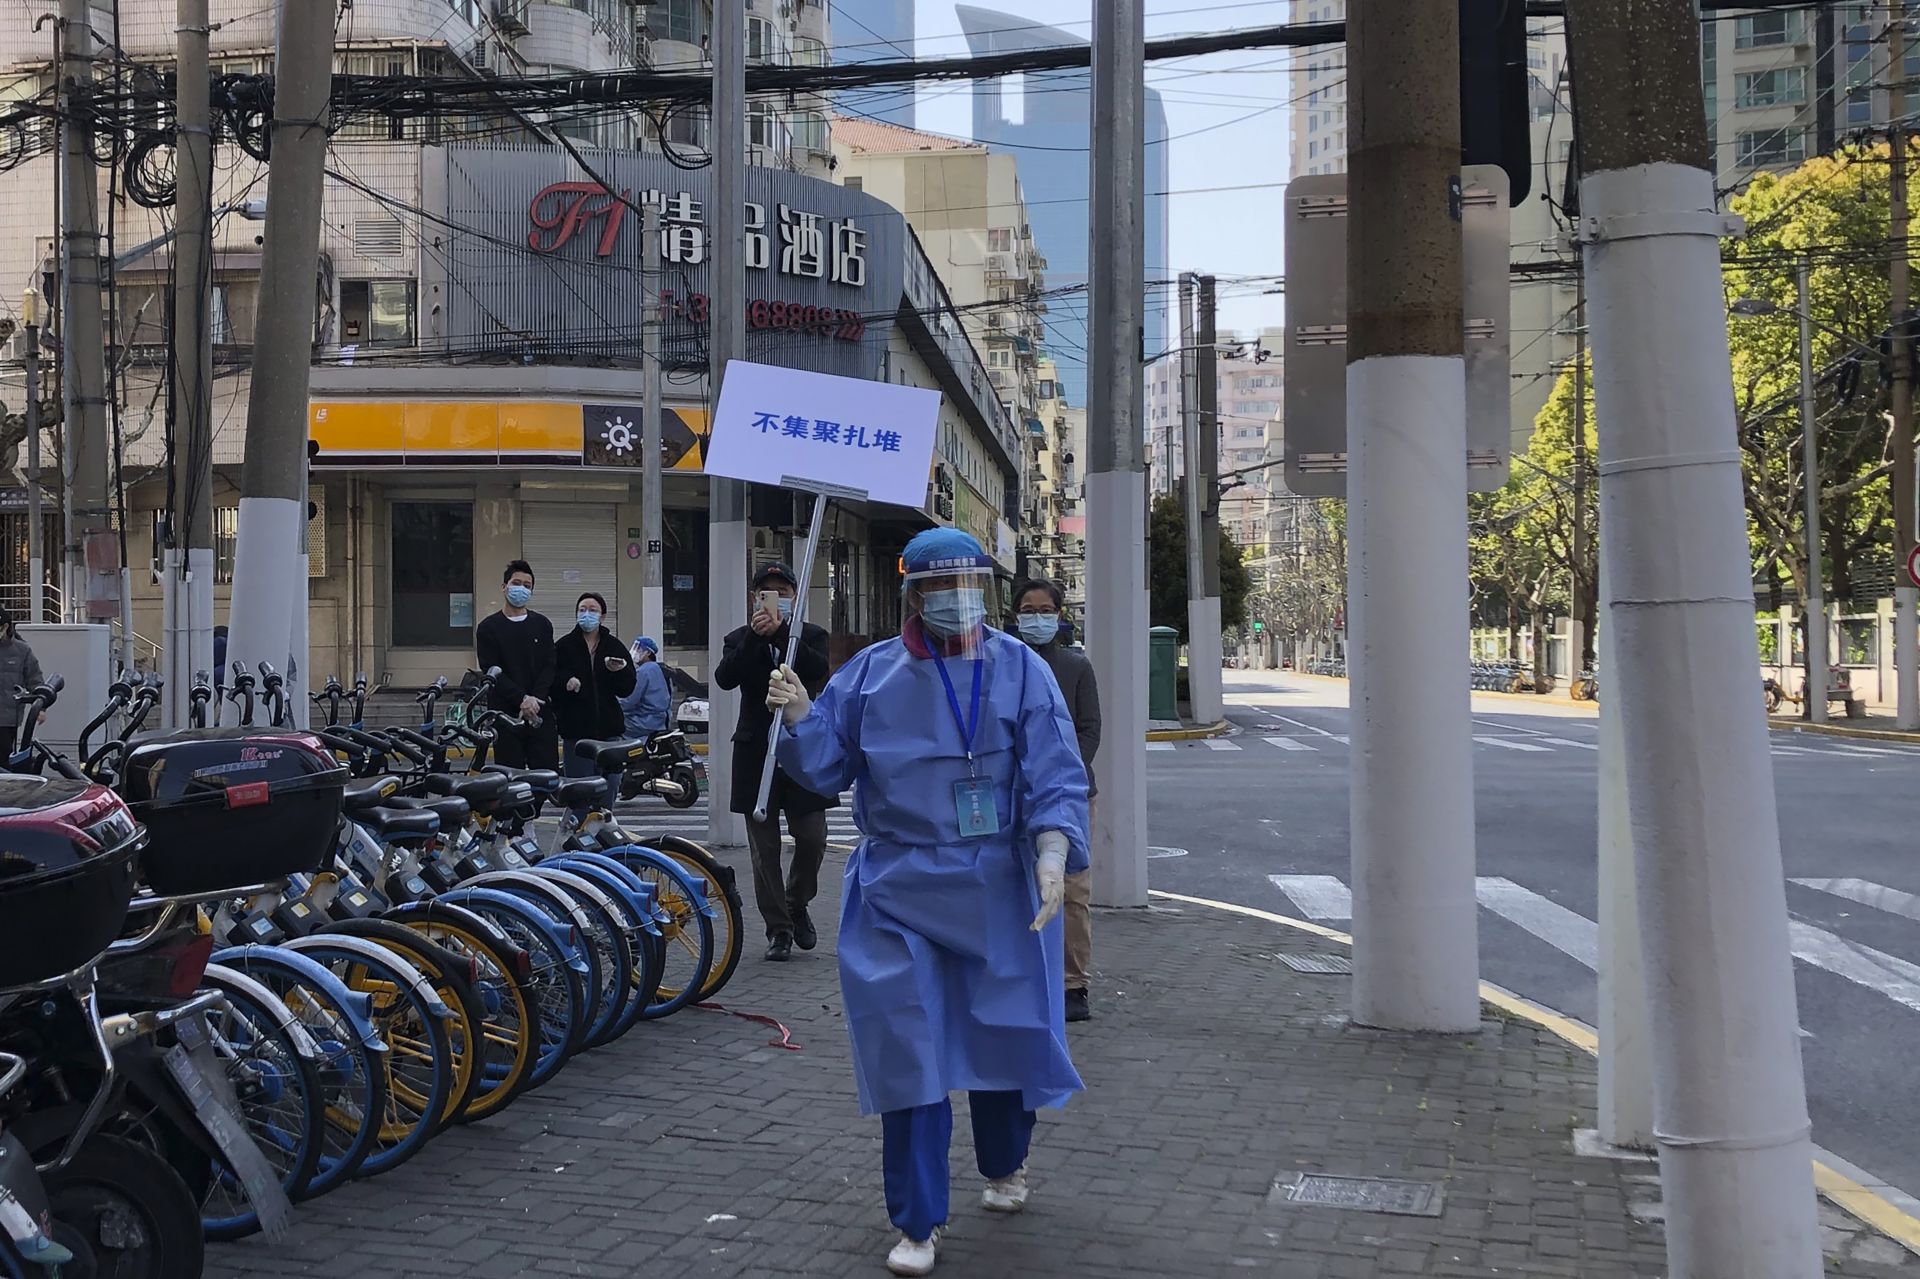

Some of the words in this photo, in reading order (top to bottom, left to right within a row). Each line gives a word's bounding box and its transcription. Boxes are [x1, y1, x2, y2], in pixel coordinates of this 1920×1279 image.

[751, 411, 903, 453] 不集聚扎堆
